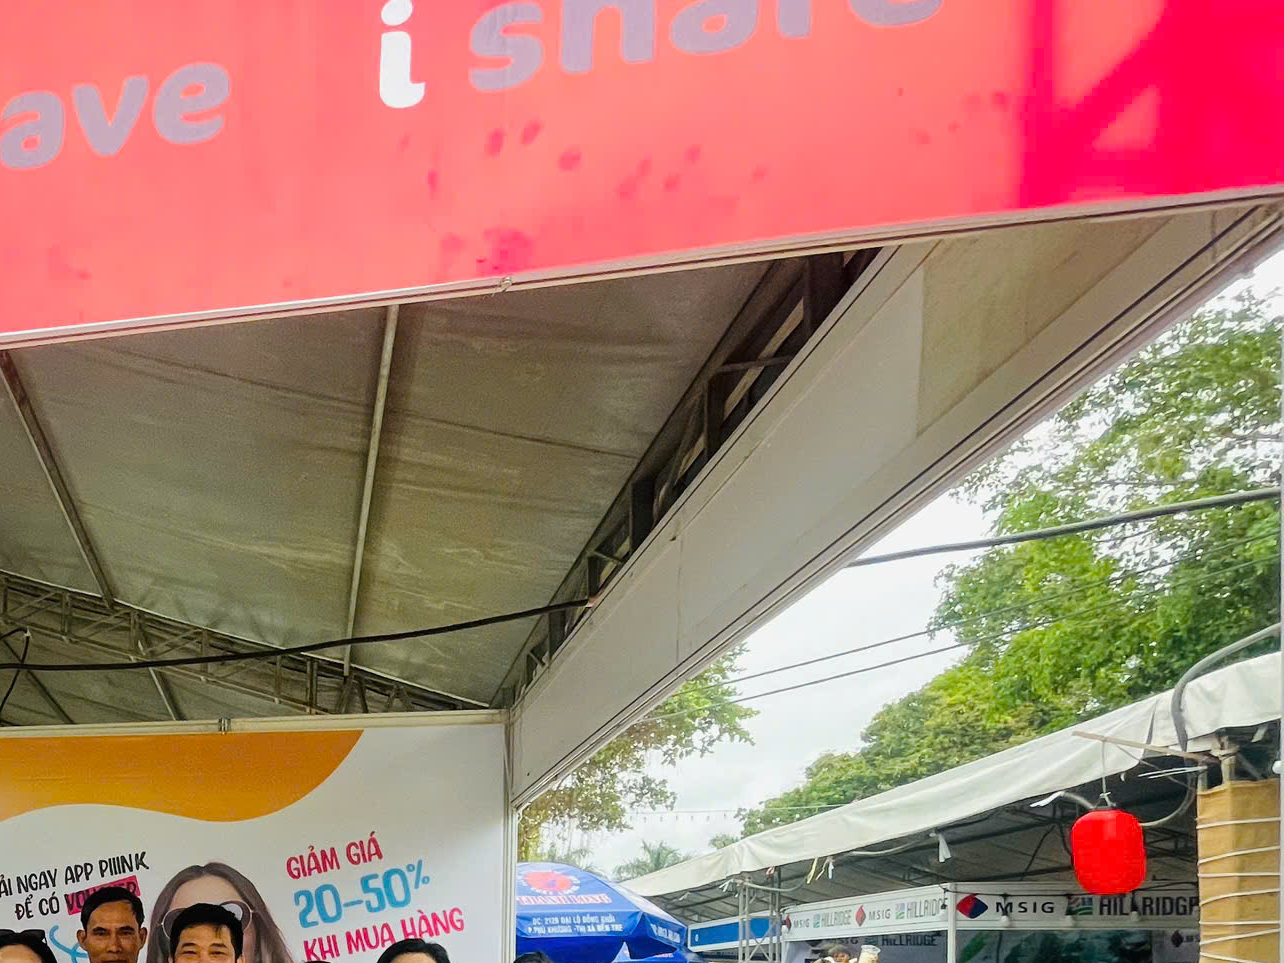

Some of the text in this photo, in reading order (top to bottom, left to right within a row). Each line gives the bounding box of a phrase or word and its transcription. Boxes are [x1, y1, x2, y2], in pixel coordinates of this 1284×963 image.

[379, 0, 426, 109] i
[16, 868, 58, 894] NGAY
[64, 862, 94, 885] APP
[98, 851, 150, 878] PIIINK
[286, 830, 384, 881] GIẢM GIÁ
[15, 892, 60, 921] ĐỂ CÓ
[293, 859, 430, 929] 20-50%
[868, 908, 891, 921] MSIG
[996, 901, 1055, 914] MSIG
[303, 907, 465, 962] KHI MUA HÀNG
